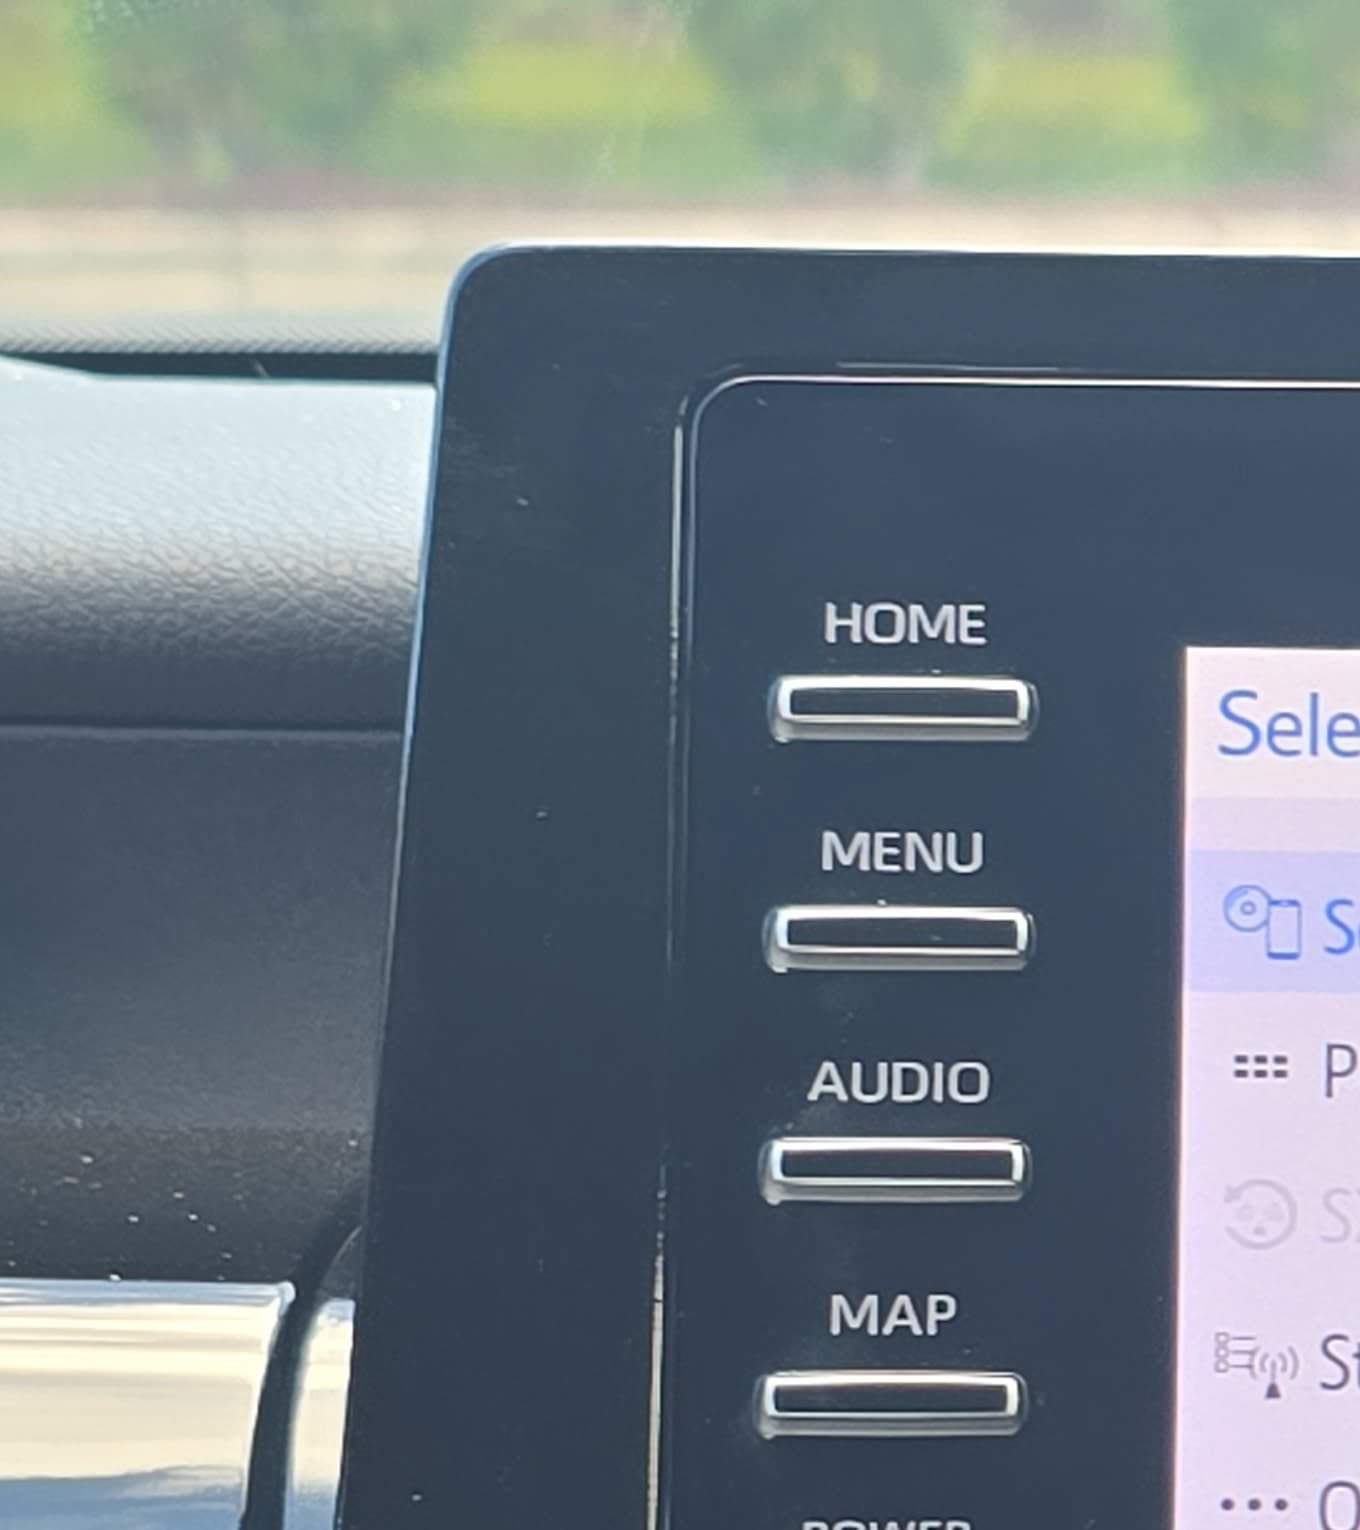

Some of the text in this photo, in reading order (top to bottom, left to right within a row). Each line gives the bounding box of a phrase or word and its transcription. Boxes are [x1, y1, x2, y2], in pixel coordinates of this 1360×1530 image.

[824, 603, 987, 645] HOME
[821, 831, 984, 872] MENU
[807, 1061, 991, 1103] AUDIO
[829, 1293, 957, 1336] MAP
